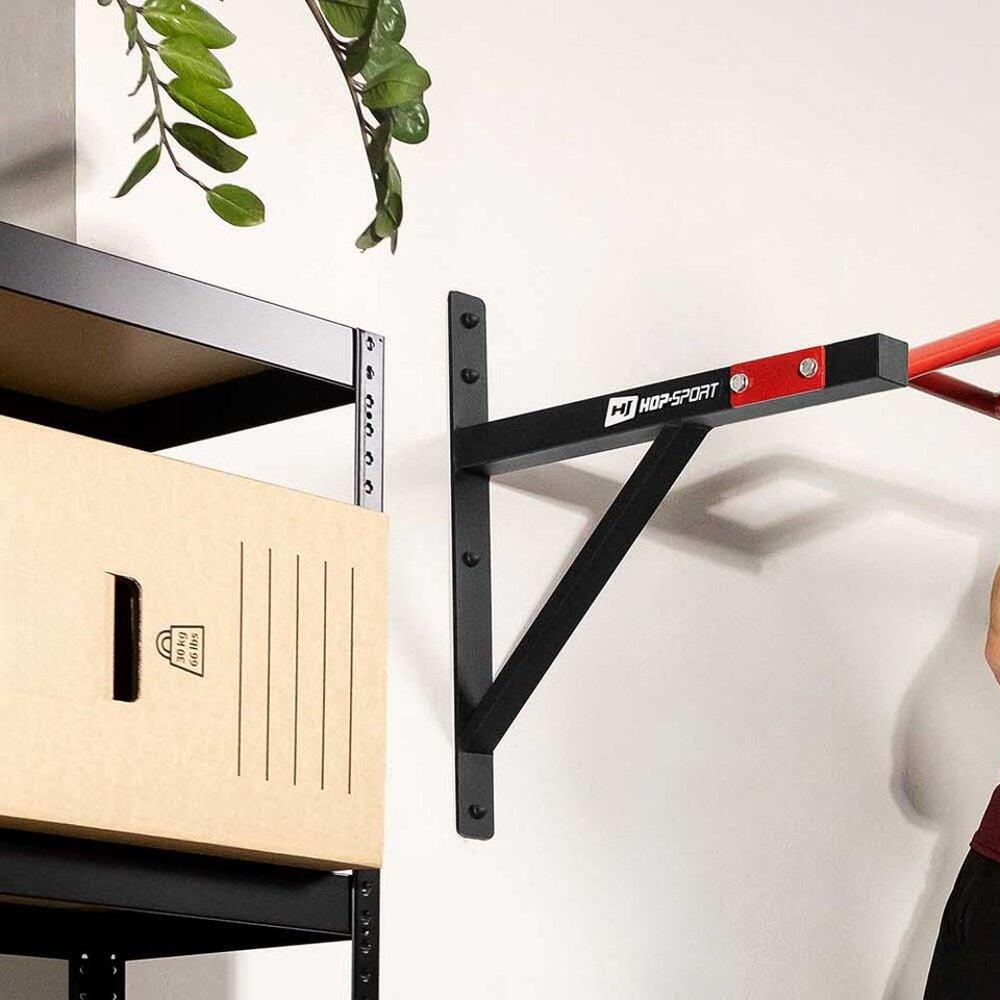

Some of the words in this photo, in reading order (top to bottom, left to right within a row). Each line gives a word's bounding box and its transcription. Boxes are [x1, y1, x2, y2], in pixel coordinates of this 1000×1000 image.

[177, 631, 188, 647] kg
[189, 633, 199, 651] lbs
[176, 649, 186, 663] 30
[189, 652, 199, 667] 66
